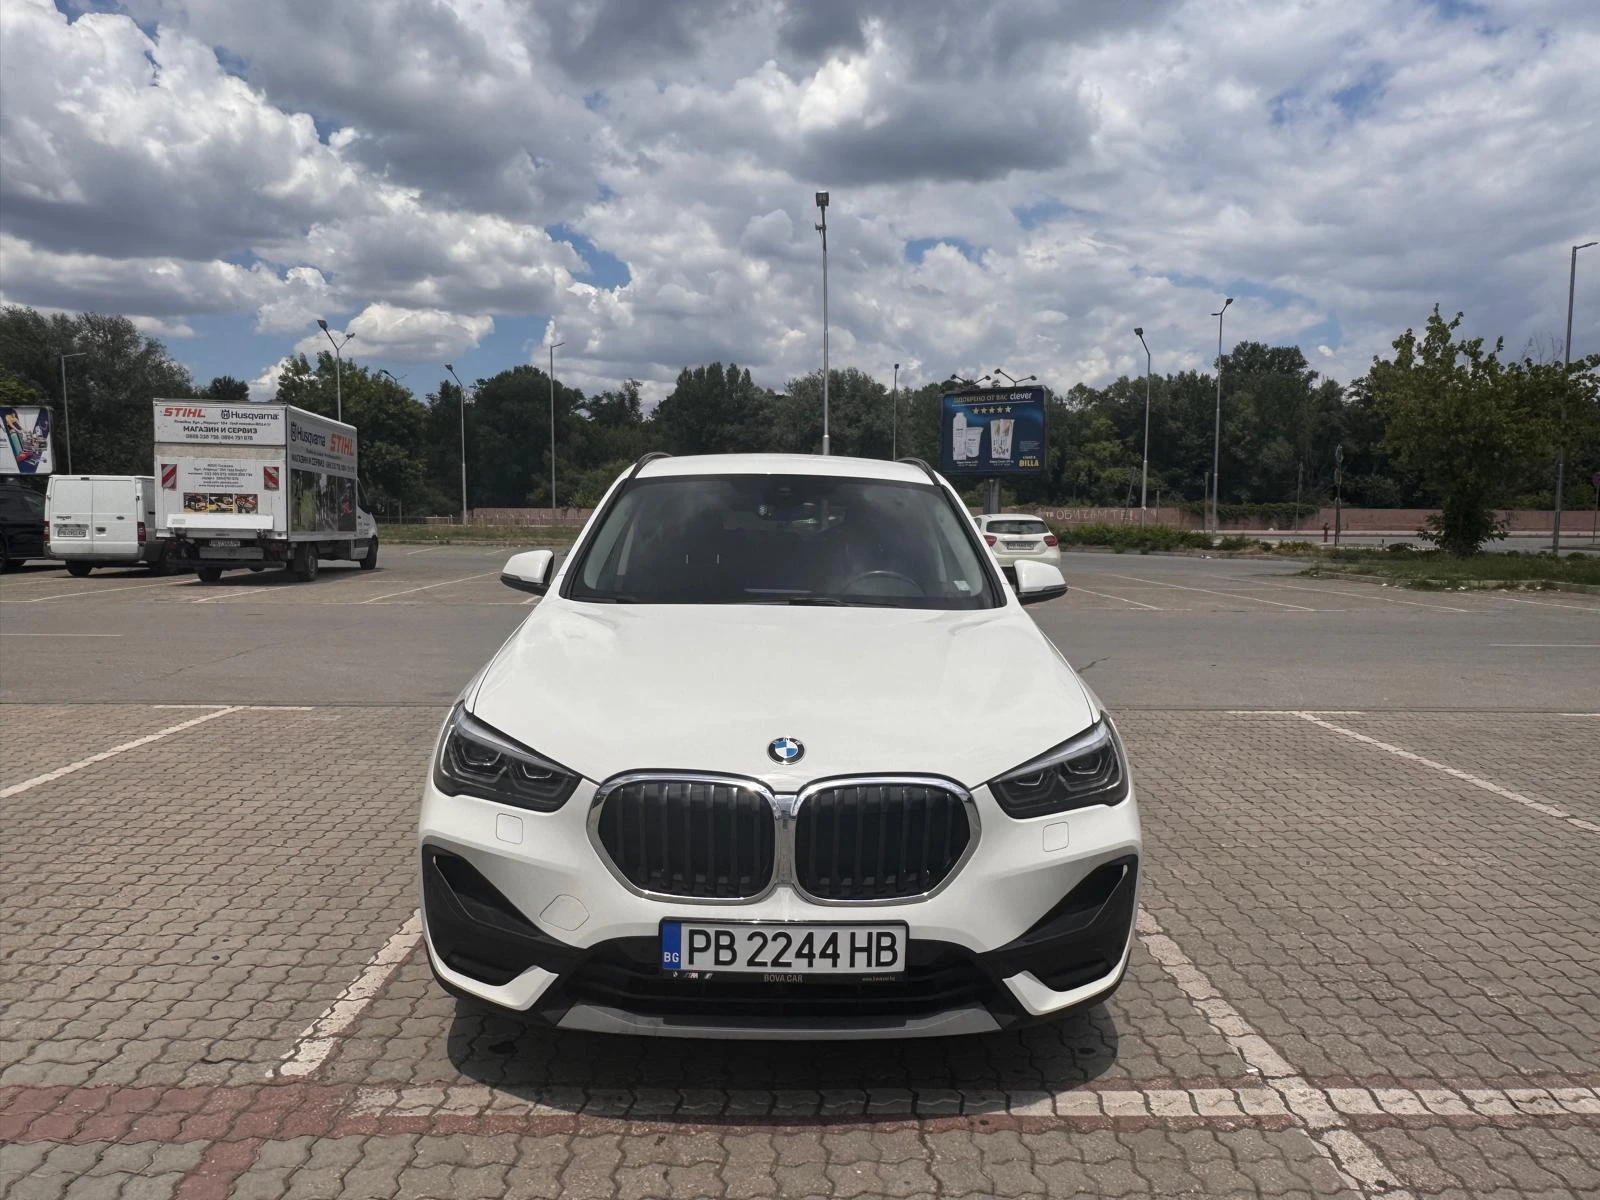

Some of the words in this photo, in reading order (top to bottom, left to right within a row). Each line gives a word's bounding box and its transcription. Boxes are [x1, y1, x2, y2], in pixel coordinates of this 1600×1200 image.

[1009, 392, 1032, 400] clever
[163, 407, 206, 418] STIHL
[230, 409, 278, 420] Husqvarna
[183, 425, 219, 433] МАГАЗИН
[330, 433, 354, 456] STIHL
[1018, 459, 1040, 467] BILLA
[688, 928, 738, 966] PB
[746, 931, 840, 968] 2244
[849, 931, 898, 968] HB
[663, 951, 680, 963] BG
[763, 973, 785, 983] BOVA
[786, 974, 803, 983] CAR
